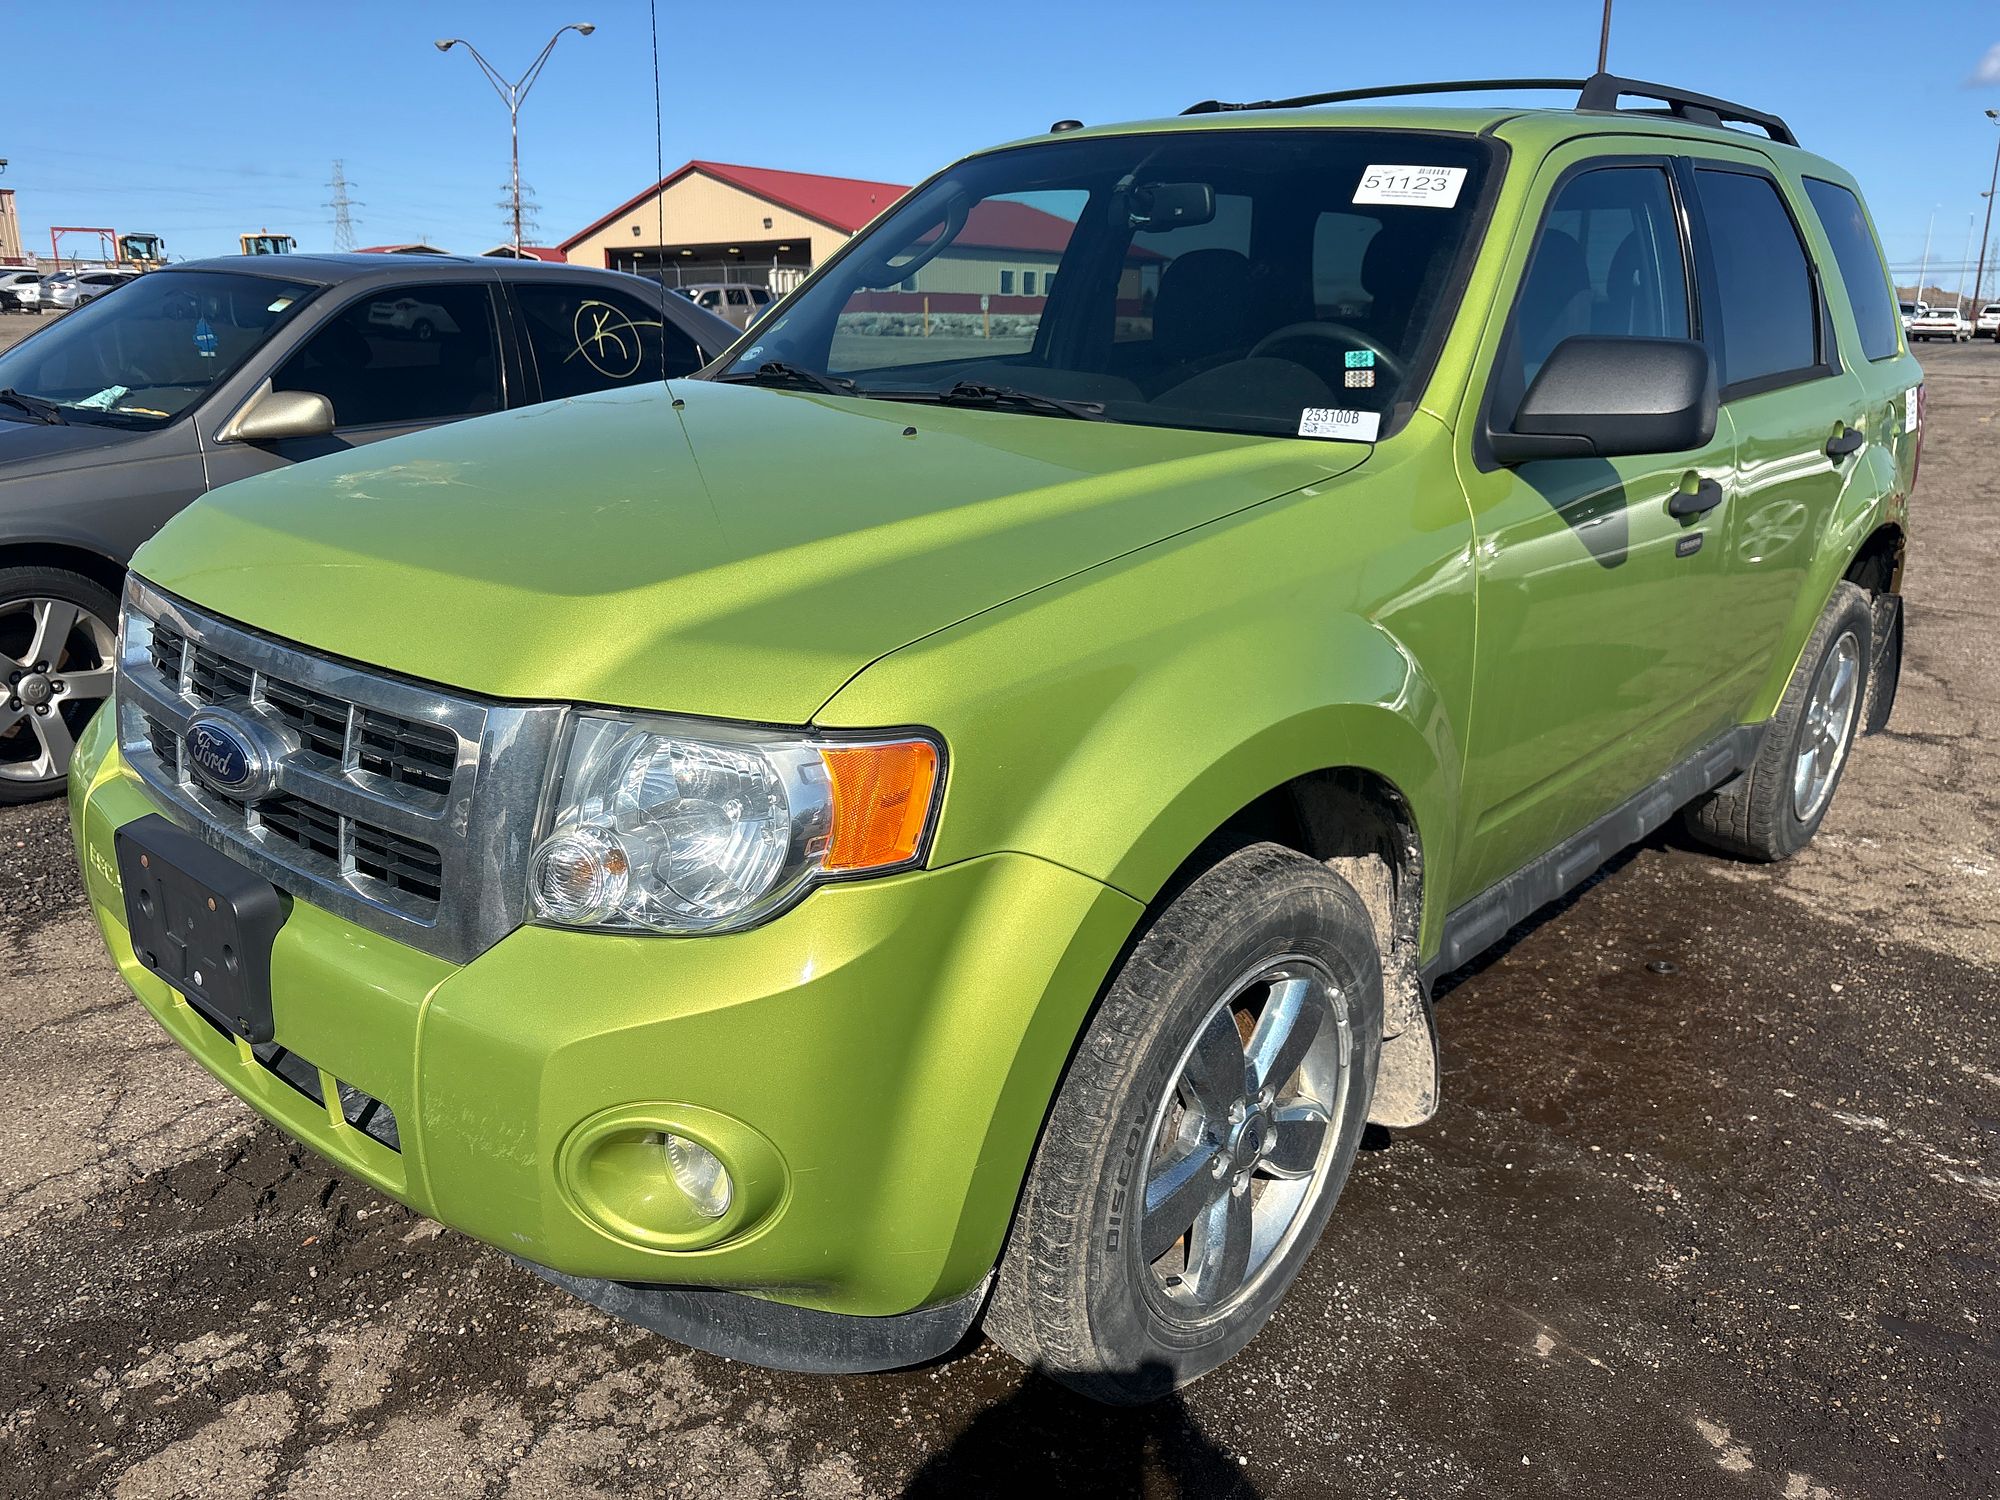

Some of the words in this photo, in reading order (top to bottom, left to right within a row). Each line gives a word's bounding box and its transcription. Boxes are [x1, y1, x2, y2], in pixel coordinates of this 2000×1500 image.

[1363, 175, 1447, 192] 51123
[1305, 408, 1360, 425] 253100B
[193, 730, 233, 776] Ford
